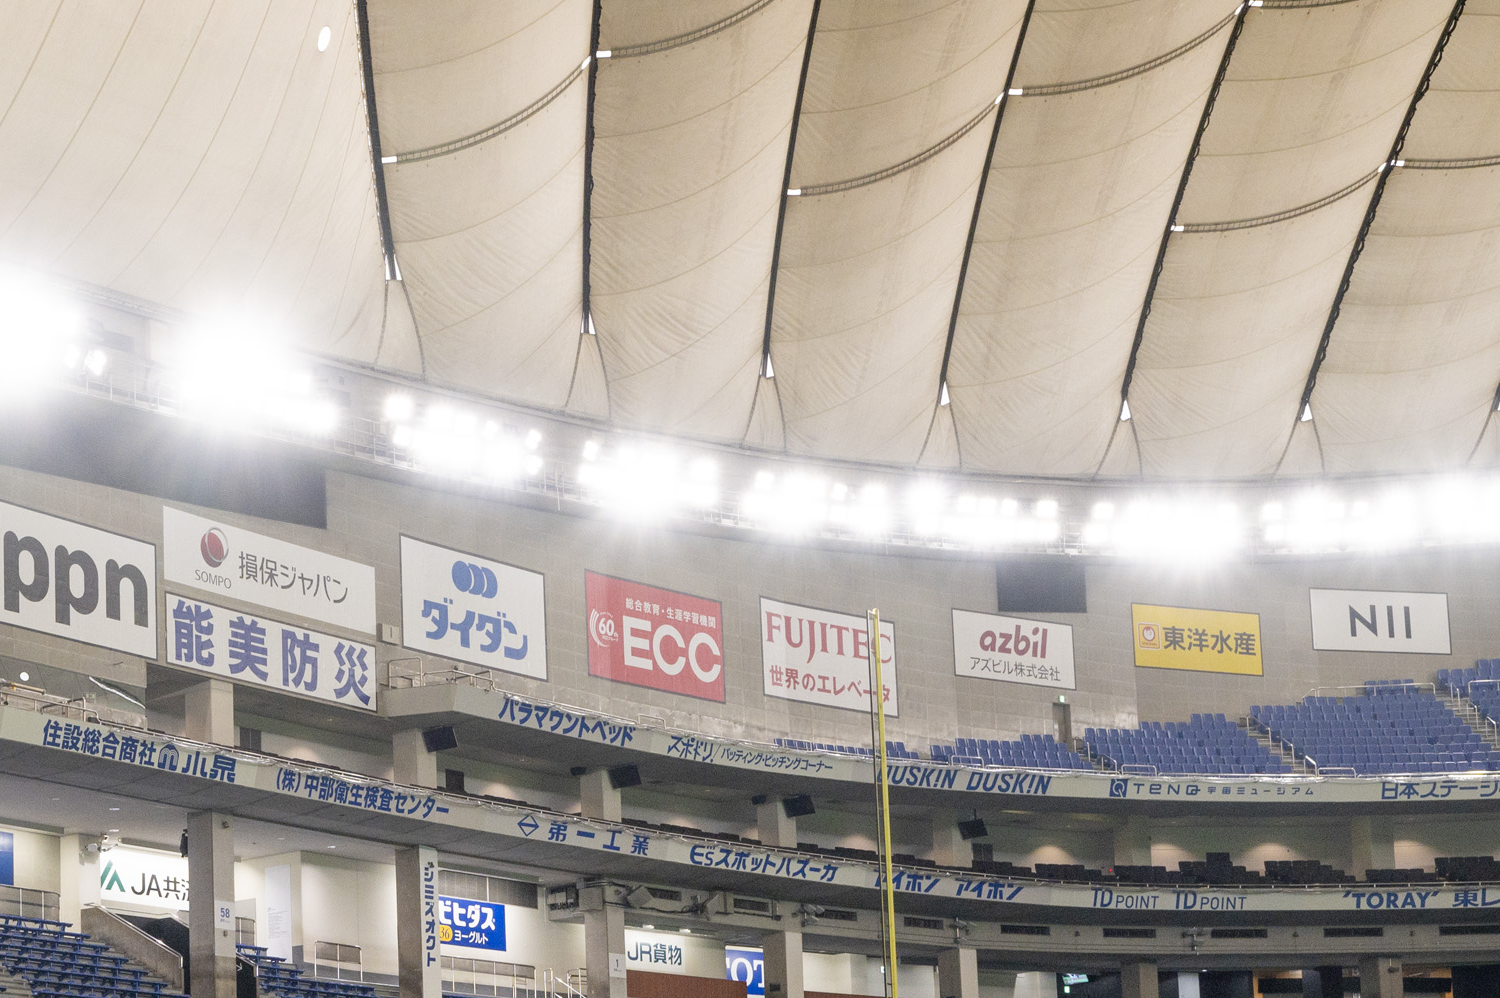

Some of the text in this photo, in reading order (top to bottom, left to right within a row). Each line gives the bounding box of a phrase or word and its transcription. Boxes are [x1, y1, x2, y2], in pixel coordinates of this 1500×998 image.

[195, 569, 232, 589] SOMPO
[239, 551, 348, 603] 損保ジャパン
[422, 597, 528, 660] ダイダン
[765, 611, 892, 664] FUJITEC
[1349, 605, 1412, 639] NII
[172, 599, 371, 706] 能美防災
[622, 615, 721, 683] ECC
[979, 624, 1049, 659] azbil
[1163, 626, 1257, 657] 東洋水産
[969, 656, 1061, 682] アズビル株式会社
[498, 698, 637, 747] パラマウントベッド
[43, 719, 157, 767] 住設総合商社
[955, 878, 1025, 901] アイホン
[1116, 894, 1160, 910] POINT
[1200, 896, 1248, 911] POINT
[220, 907, 230, 919] 58
[454, 929, 489, 945] ヨーグルト
[627, 941, 682, 966] JR貨物
